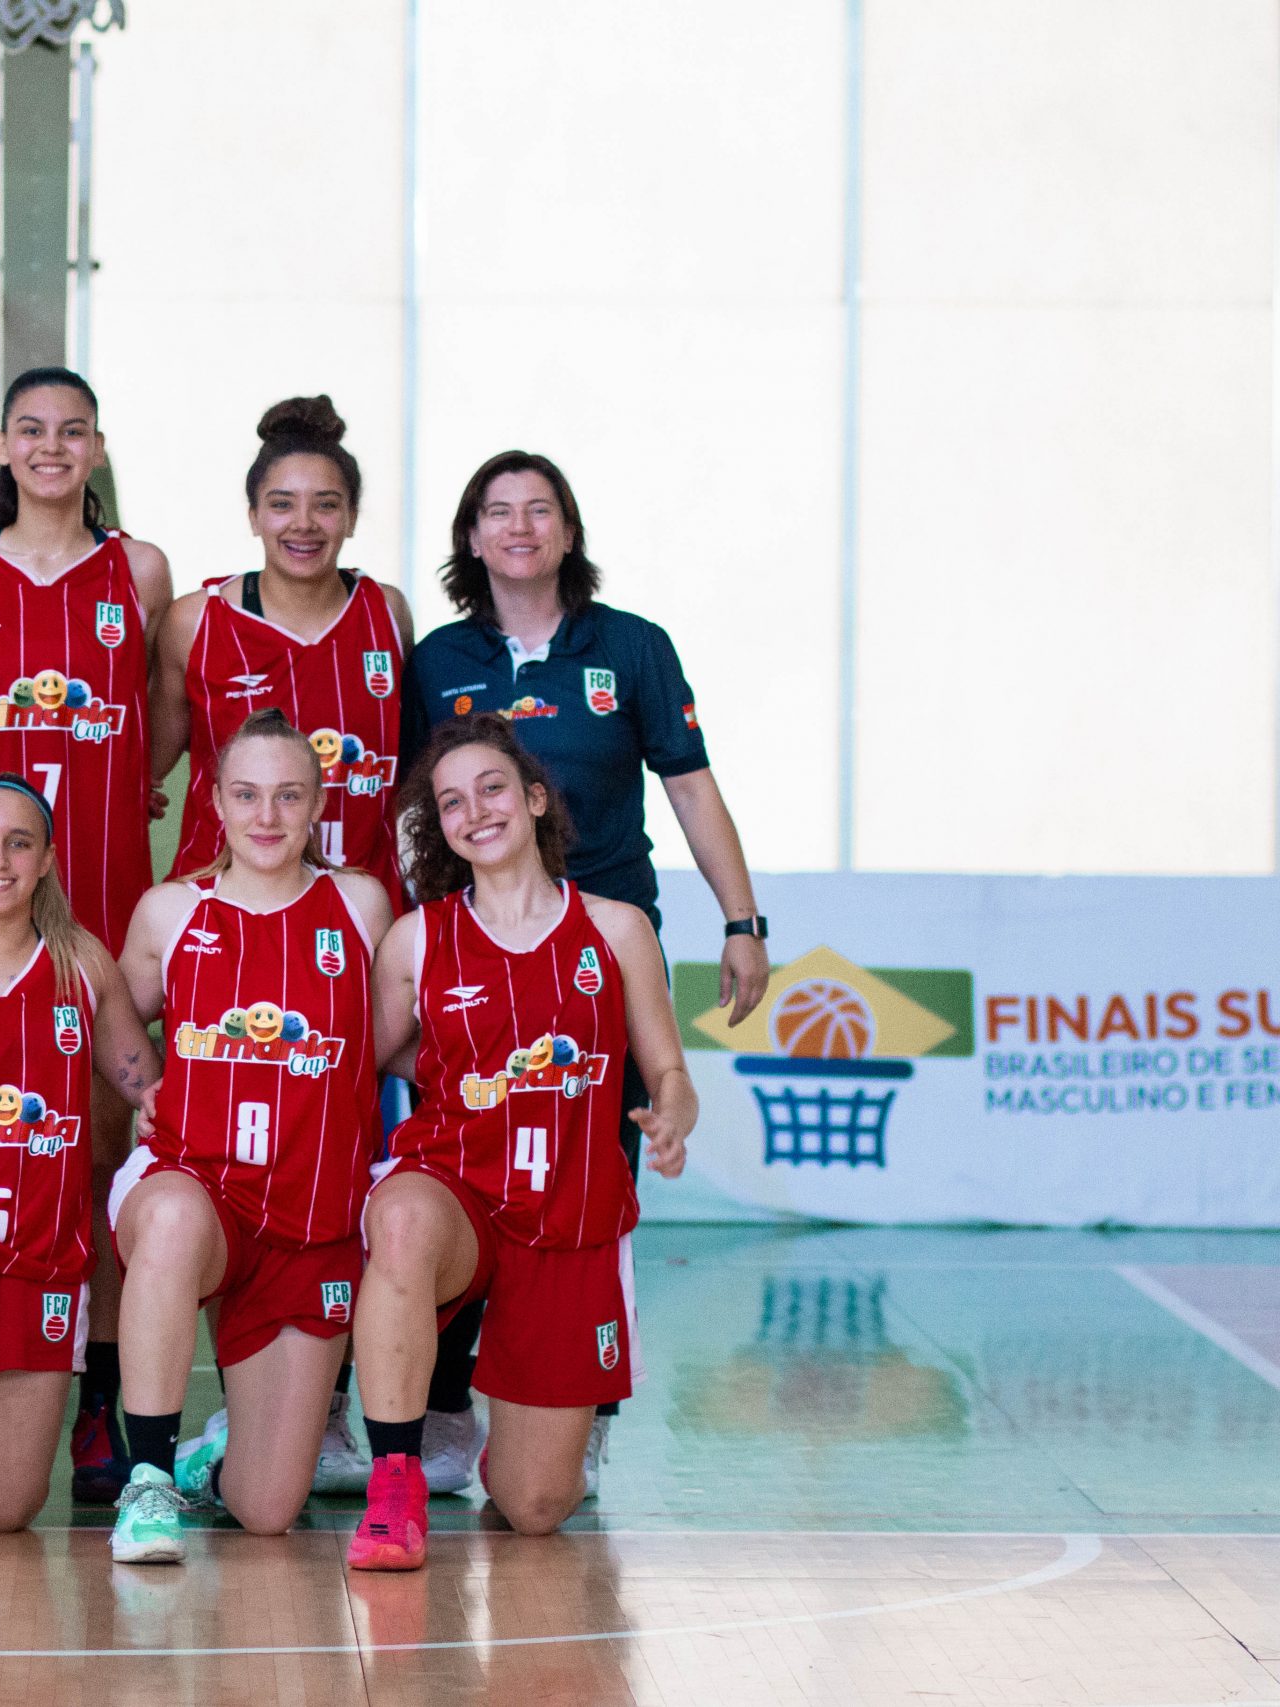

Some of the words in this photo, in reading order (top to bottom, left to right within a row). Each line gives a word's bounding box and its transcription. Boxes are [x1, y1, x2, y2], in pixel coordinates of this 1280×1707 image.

[100, 605, 121, 624] FCB
[366, 654, 387, 671] FCB
[590, 672, 612, 689] FCB
[226, 686, 273, 698] PENALTY
[74, 721, 109, 742] Cap
[33, 763, 62, 812] 7
[349, 775, 382, 795] Cap
[183, 944, 222, 954] ENALTY
[442, 996, 489, 1013] PENALTY
[56, 1008, 78, 1028] FCB
[985, 992, 1199, 1042] FINAIS
[178, 1024, 343, 1066] trimania
[290, 1055, 327, 1077] Cap
[985, 1048, 1178, 1079] BRASILEIRO
[1187, 1047, 1229, 1076] DE
[985, 1083, 1187, 1114] MASCULINO
[1196, 1082, 1217, 1110] E
[236, 1101, 270, 1166] 8
[30, 1136, 62, 1156] Cap
[514, 1127, 550, 1192] 4
[325, 1284, 350, 1304] FCB
[46, 1296, 68, 1315] FCB
